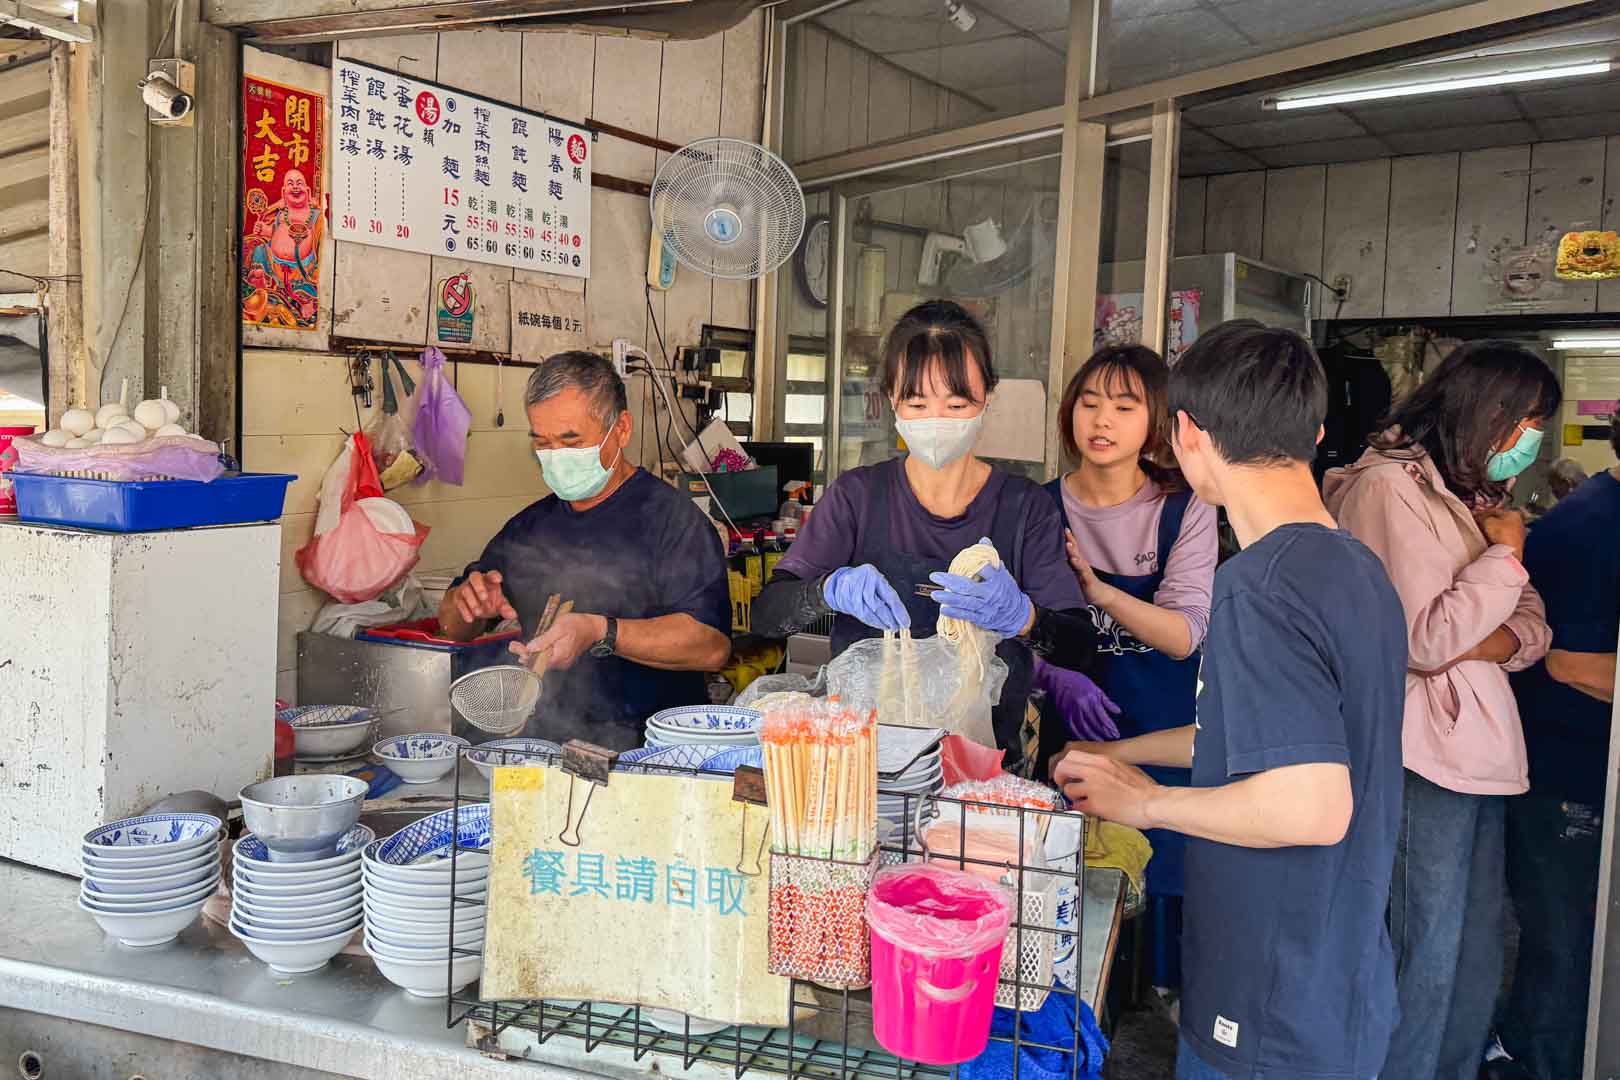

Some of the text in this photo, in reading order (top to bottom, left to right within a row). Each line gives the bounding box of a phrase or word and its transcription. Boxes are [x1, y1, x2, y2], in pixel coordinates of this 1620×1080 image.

[253, 108, 283, 182] 大吉
[283, 95, 310, 168] 開市
[366, 77, 387, 234] 餛飩湯 30
[393, 85, 414, 239] 蛋花湯 20
[511, 117, 529, 193] 餛飩麵
[548, 127, 564, 201] 陽春麵
[342, 215, 356, 230] 30
[466, 215, 479, 230] 55
[486, 218, 498, 233] 50
[505, 222, 517, 237] 55
[523, 226, 535, 240] 50
[540, 229, 552, 243] 45
[558, 233, 569, 246] 40
[467, 236, 479, 250] 65
[486, 239, 497, 254] 60
[505, 243, 517, 257] 65
[523, 246, 534, 259] 60
[540, 250, 552, 263] 55
[558, 253, 568, 265] 50
[521, 847, 748, 918] 餐具請自取
